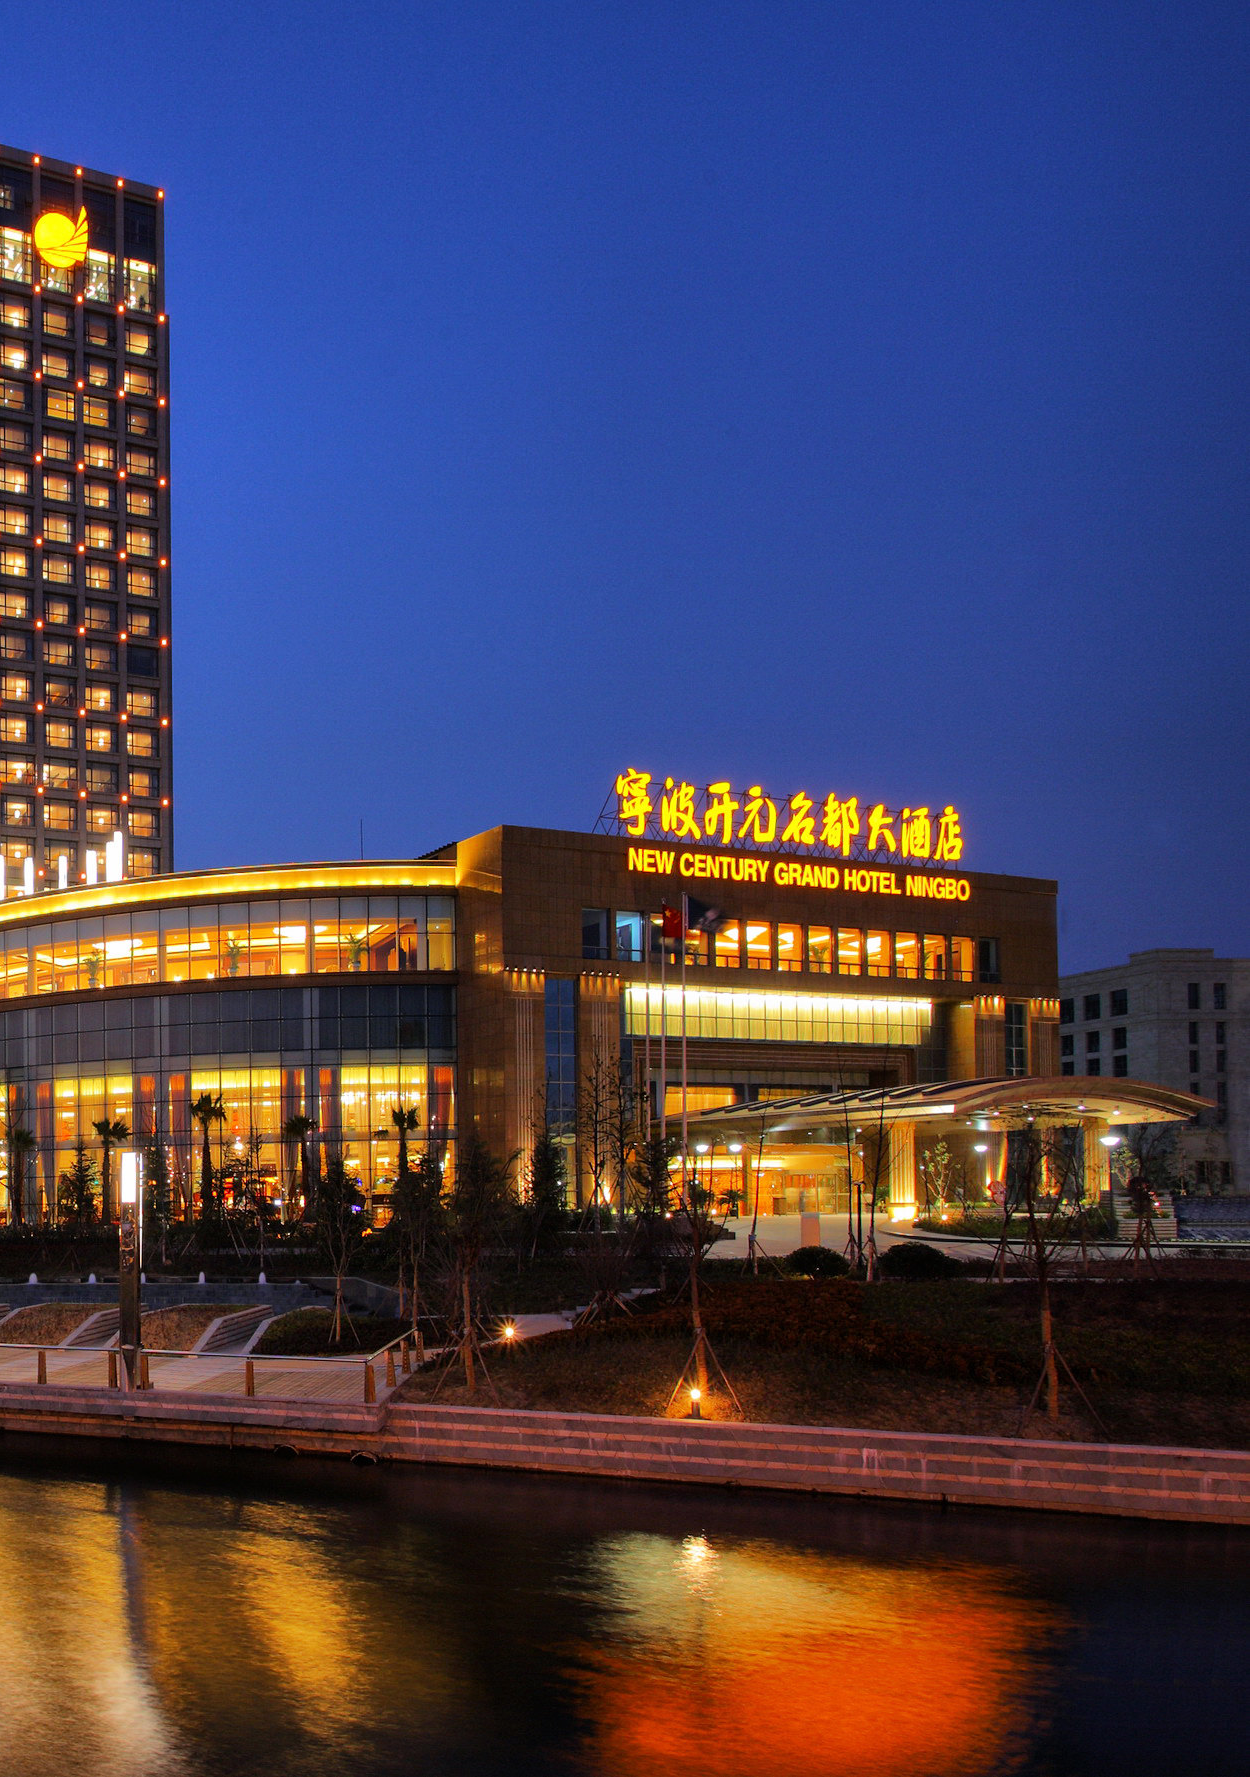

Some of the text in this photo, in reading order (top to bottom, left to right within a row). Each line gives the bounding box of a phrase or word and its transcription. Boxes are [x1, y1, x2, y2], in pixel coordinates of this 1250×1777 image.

[628, 846, 971, 902] NEW CENTURY GRAND HOTEL NINGBO
